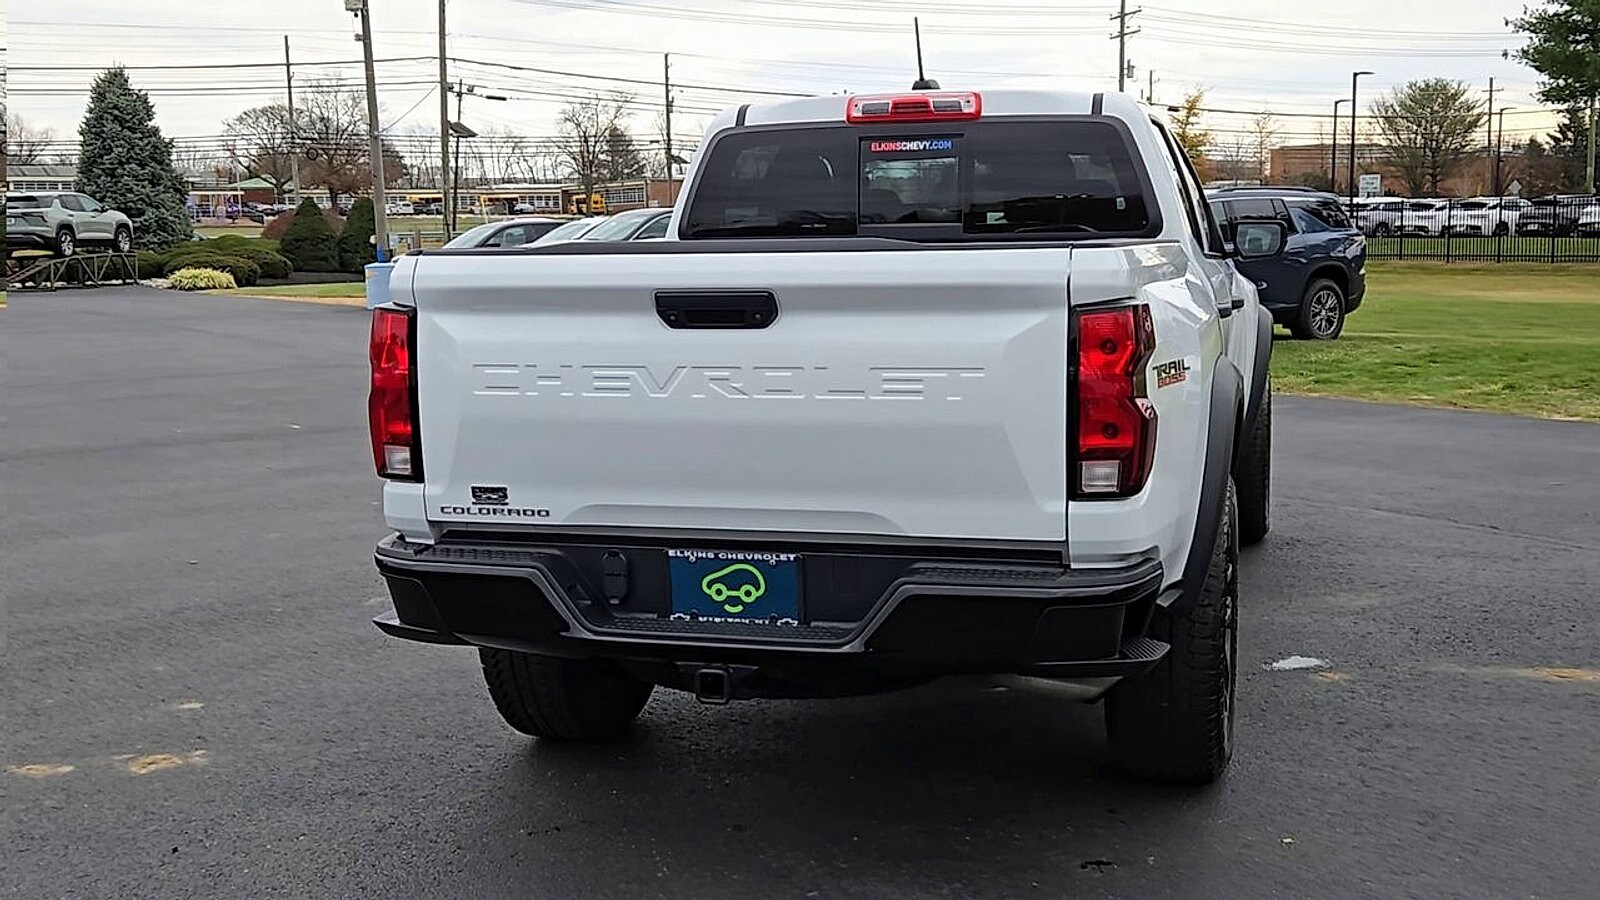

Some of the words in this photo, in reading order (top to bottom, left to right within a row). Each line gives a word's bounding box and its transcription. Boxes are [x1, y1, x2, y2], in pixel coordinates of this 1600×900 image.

[871, 140, 953, 152] ELKINSCHEVY.COM
[1152, 358, 1191, 378] TRAIL
[472, 363, 987, 401] CHEVROLET
[1157, 371, 1187, 389] BOSS
[440, 505, 551, 518] COLORADO
[668, 548, 715, 560] ELKINS
[718, 551, 797, 562] CHEVROLET
